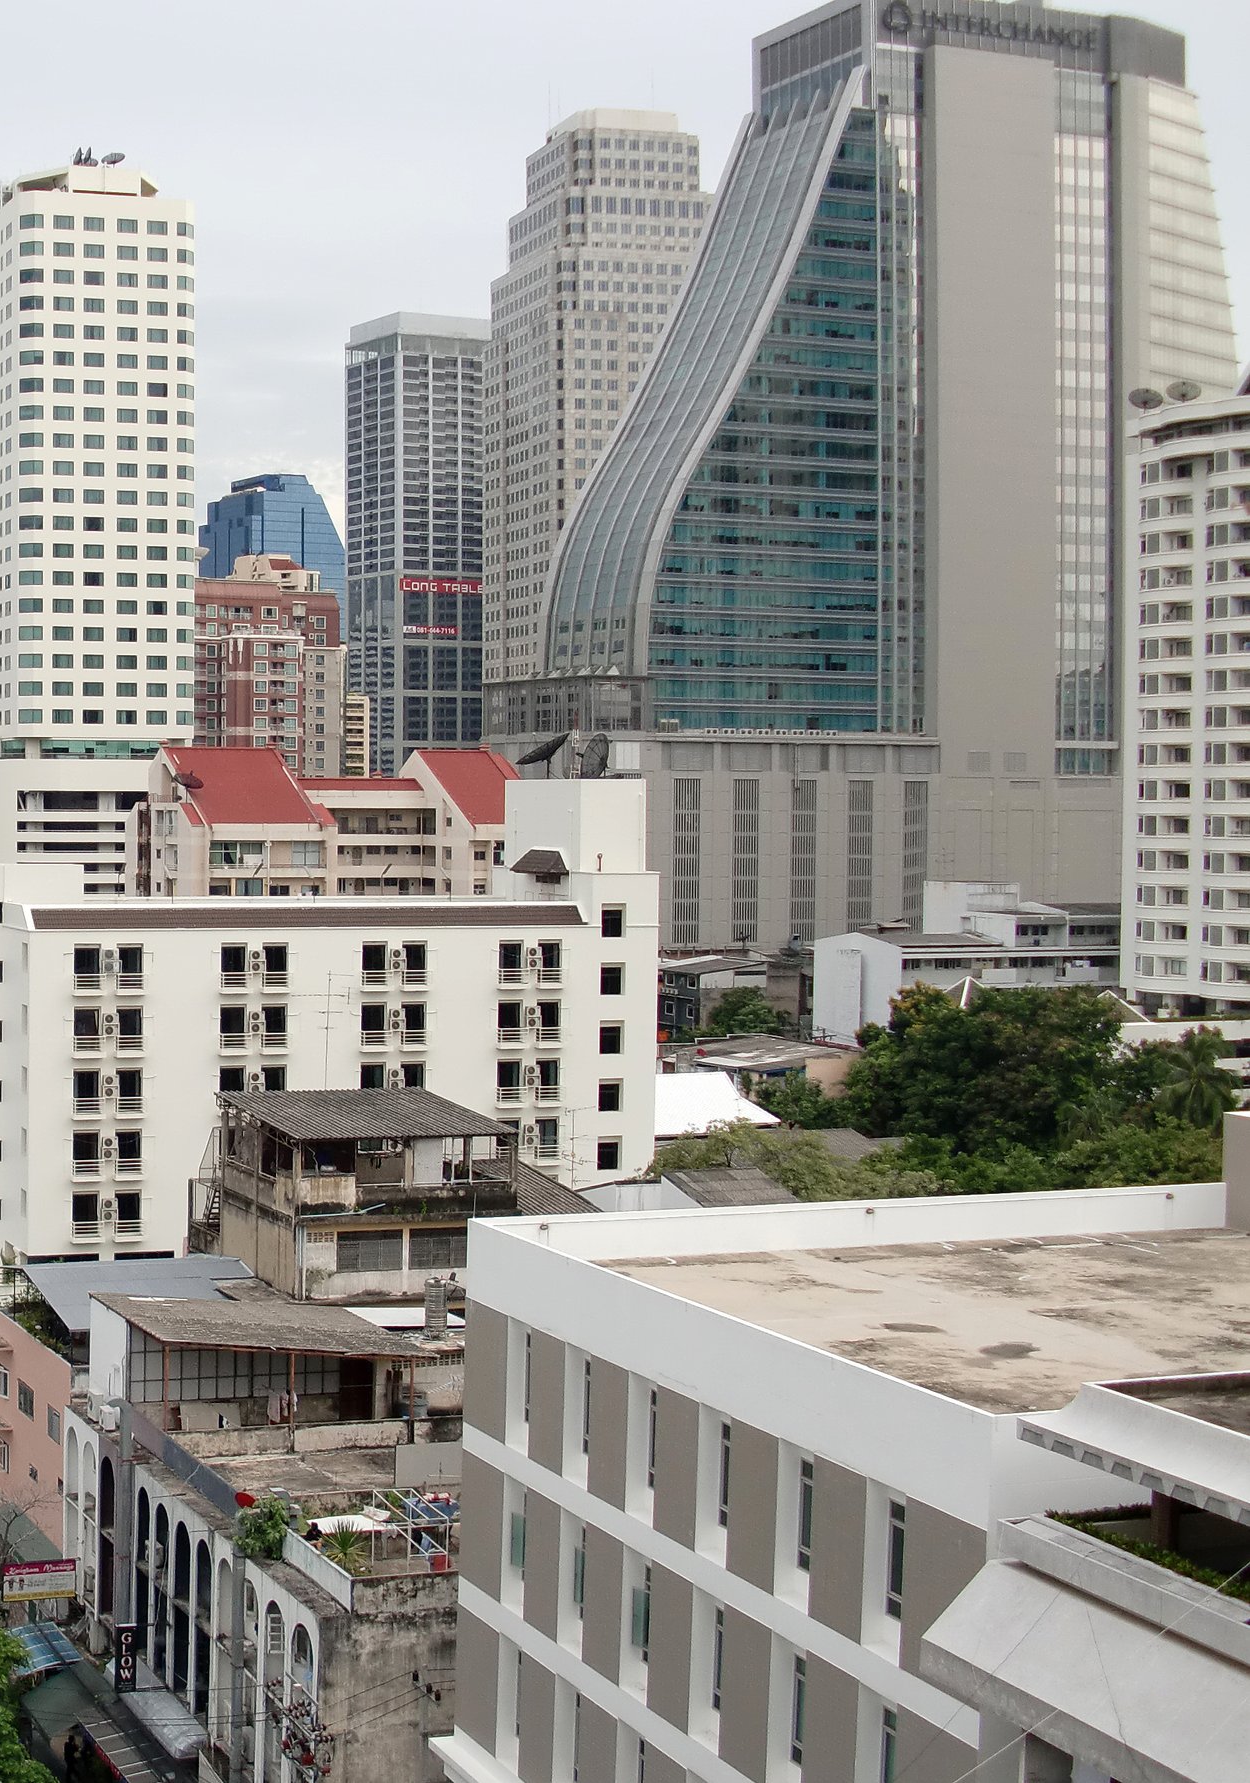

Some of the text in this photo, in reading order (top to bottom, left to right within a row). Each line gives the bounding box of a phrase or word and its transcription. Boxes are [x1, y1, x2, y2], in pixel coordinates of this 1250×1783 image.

[921, 9, 1099, 50] INTERCHANGE
[403, 580, 437, 592] LONG
[120, 1632, 132, 1680] GLOW
